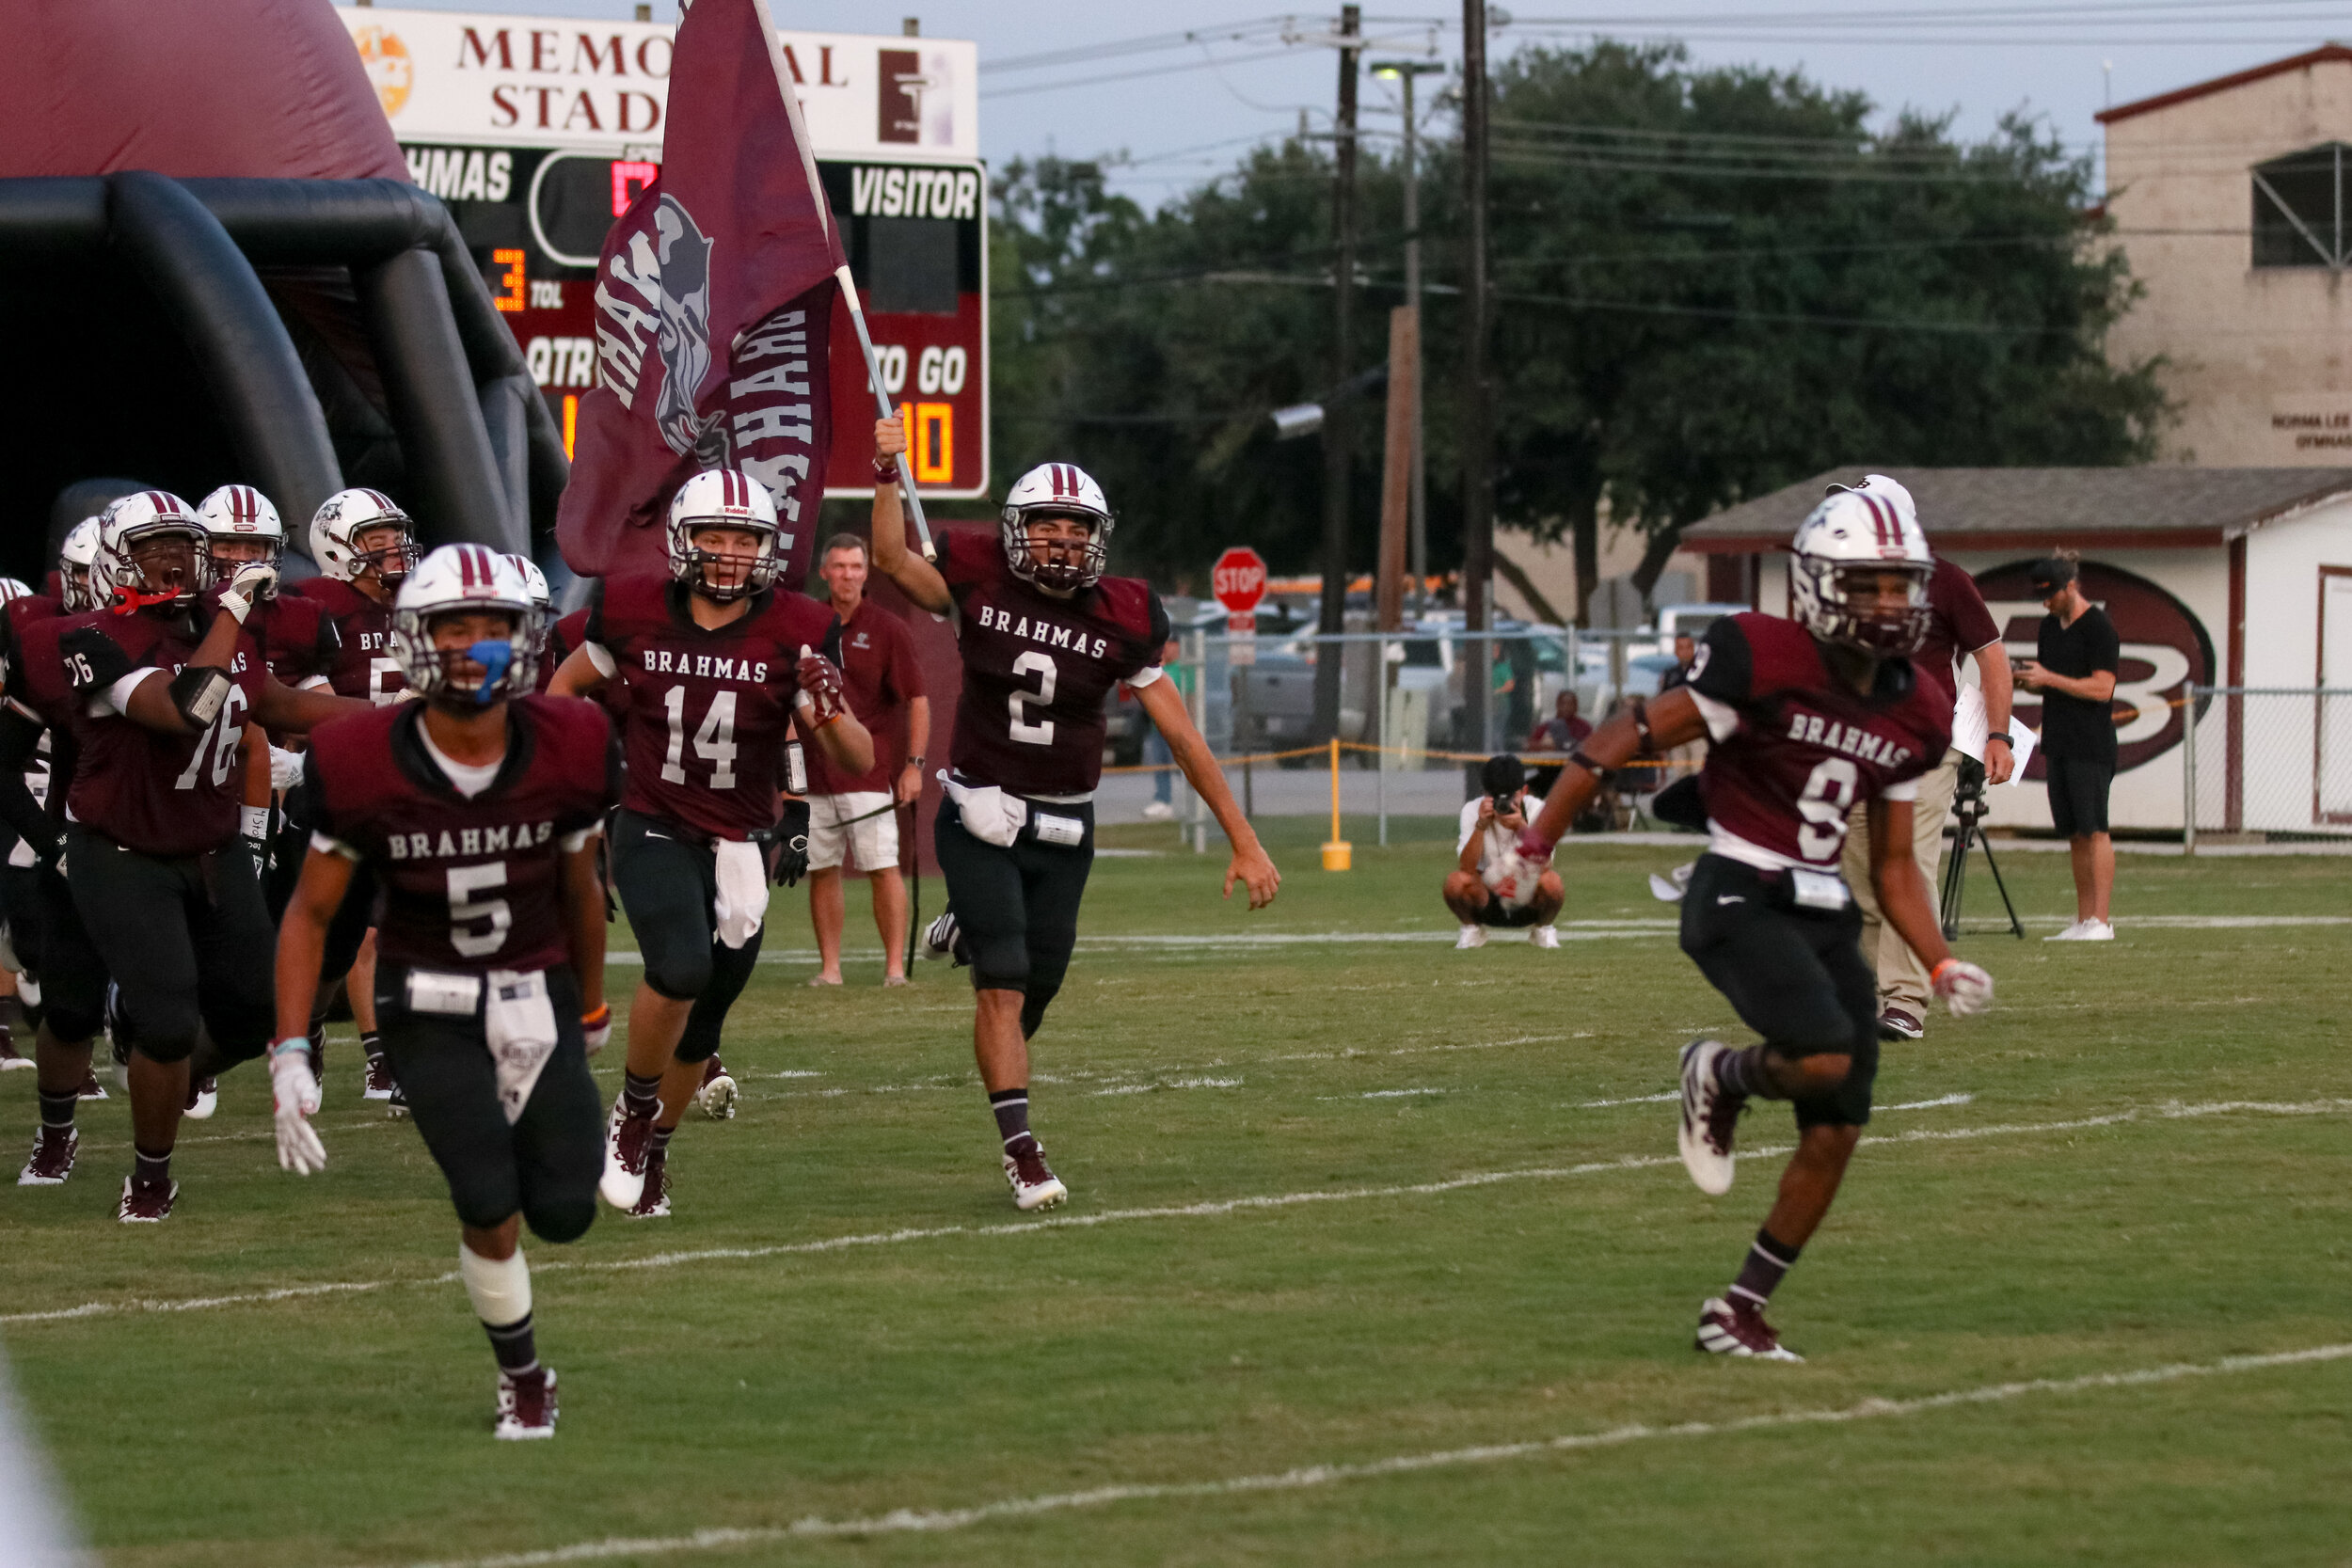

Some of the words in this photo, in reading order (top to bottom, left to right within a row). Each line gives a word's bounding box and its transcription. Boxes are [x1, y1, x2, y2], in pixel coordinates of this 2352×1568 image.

[851, 166, 977, 219] VISITOR
[493, 248, 525, 311] 3
[530, 280, 564, 309] TOL
[527, 337, 595, 388] QTR
[867, 344, 908, 394] TO
[918, 345, 966, 395] GO
[899, 402, 953, 483] 10
[1216, 567, 1263, 594] STOP
[979, 605, 1107, 659] BRAHMAS
[63, 652, 94, 688] 76
[644, 650, 768, 683] BRAHMAS
[1009, 650, 1057, 746] 2
[660, 684, 738, 789] 14
[1788, 713, 1912, 768] BRAHMAS
[388, 820, 553, 860] BRAHMAS
[446, 861, 513, 958] 5
